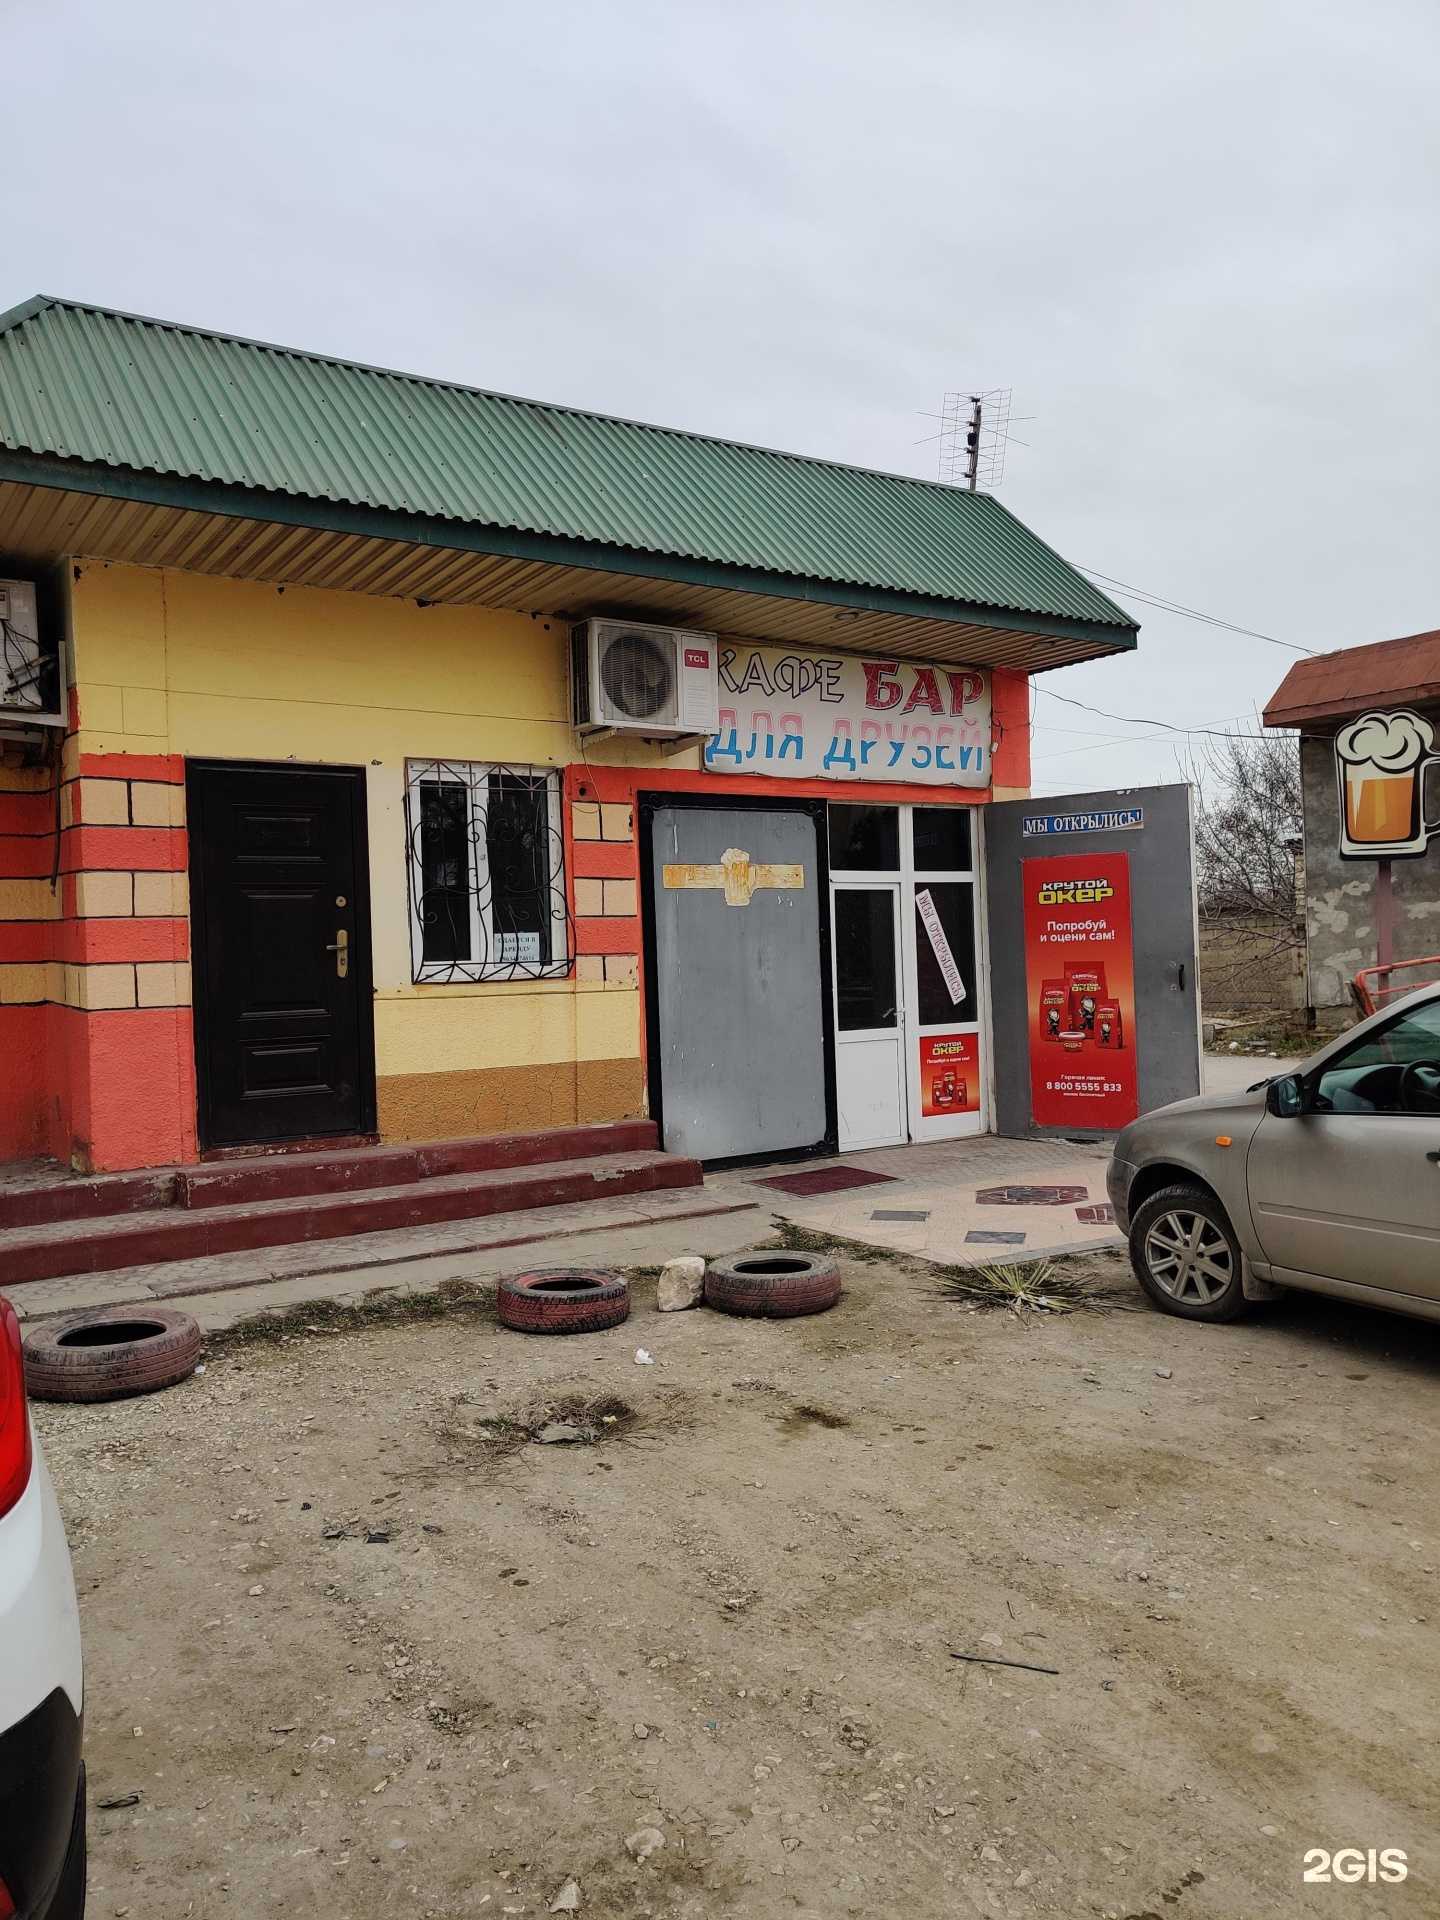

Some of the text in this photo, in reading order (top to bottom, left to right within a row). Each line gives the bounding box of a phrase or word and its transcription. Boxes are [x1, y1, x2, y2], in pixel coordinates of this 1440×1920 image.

[687, 653, 706, 664] TCL
[861, 660, 985, 717] БАР
[705, 707, 983, 772] ДЛЯ ДРУЗЕЙ
[1025, 810, 1141, 834] МЫ ОТКРЫЛИСЬ!
[1042, 878, 1108, 891] КРУТОЙ
[1047, 919, 1107, 933] Попробуй
[1040, 930, 1115, 943] и оцени сам!
[1046, 1081, 1122, 1092] 8 800 5555 833
